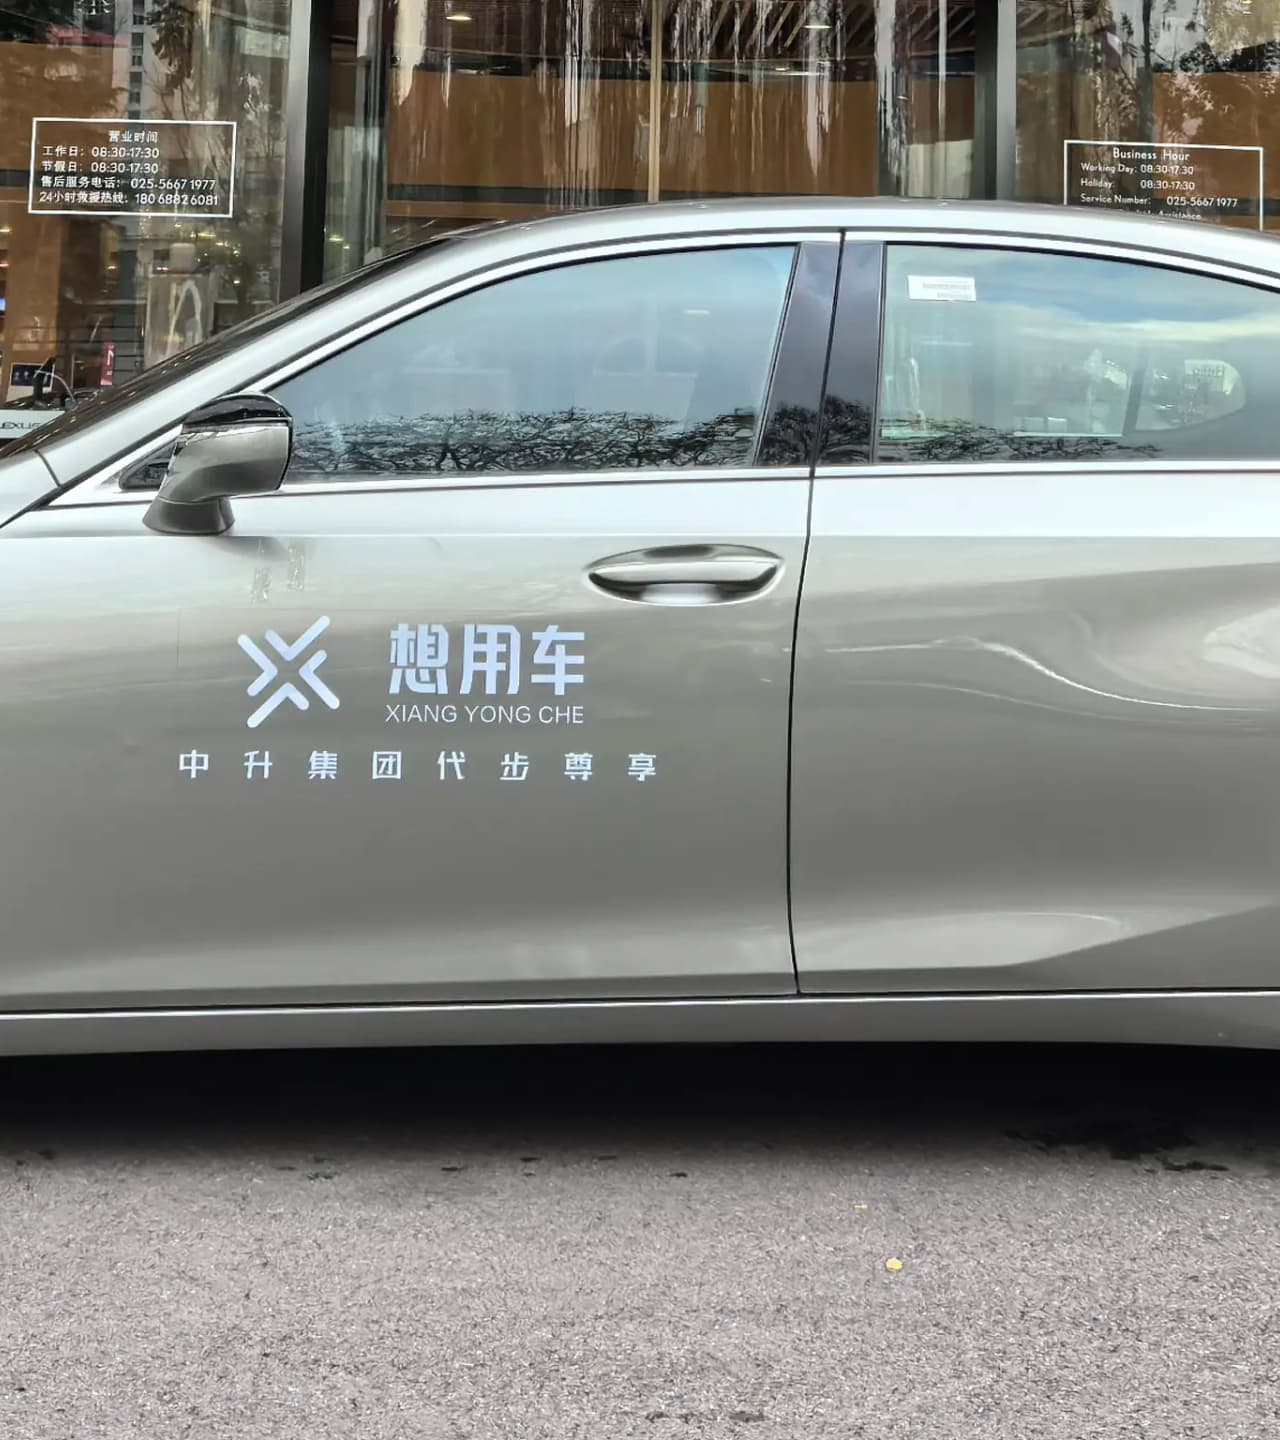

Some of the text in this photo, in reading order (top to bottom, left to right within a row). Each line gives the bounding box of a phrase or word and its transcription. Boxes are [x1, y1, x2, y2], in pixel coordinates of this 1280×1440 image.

[108, 130, 158, 143] 营业时间
[91, 147, 160, 159] 08:30-17:30
[1112, 147, 1190, 161] Business Hour
[91, 162, 160, 174] 08:30-17:30
[1080, 162, 1194, 175] Working Day: 08:30-17:30
[190, 179, 216, 191] 1977
[1140, 179, 1196, 191] 08:30-17:30
[135, 193, 156, 205] 180
[1080, 192, 1113, 203] Service
[389, 623, 586, 696] 想用车
[385, 704, 584, 725] XIANG YONG CHE
[178, 749, 658, 783] 中升集团代步尊享
